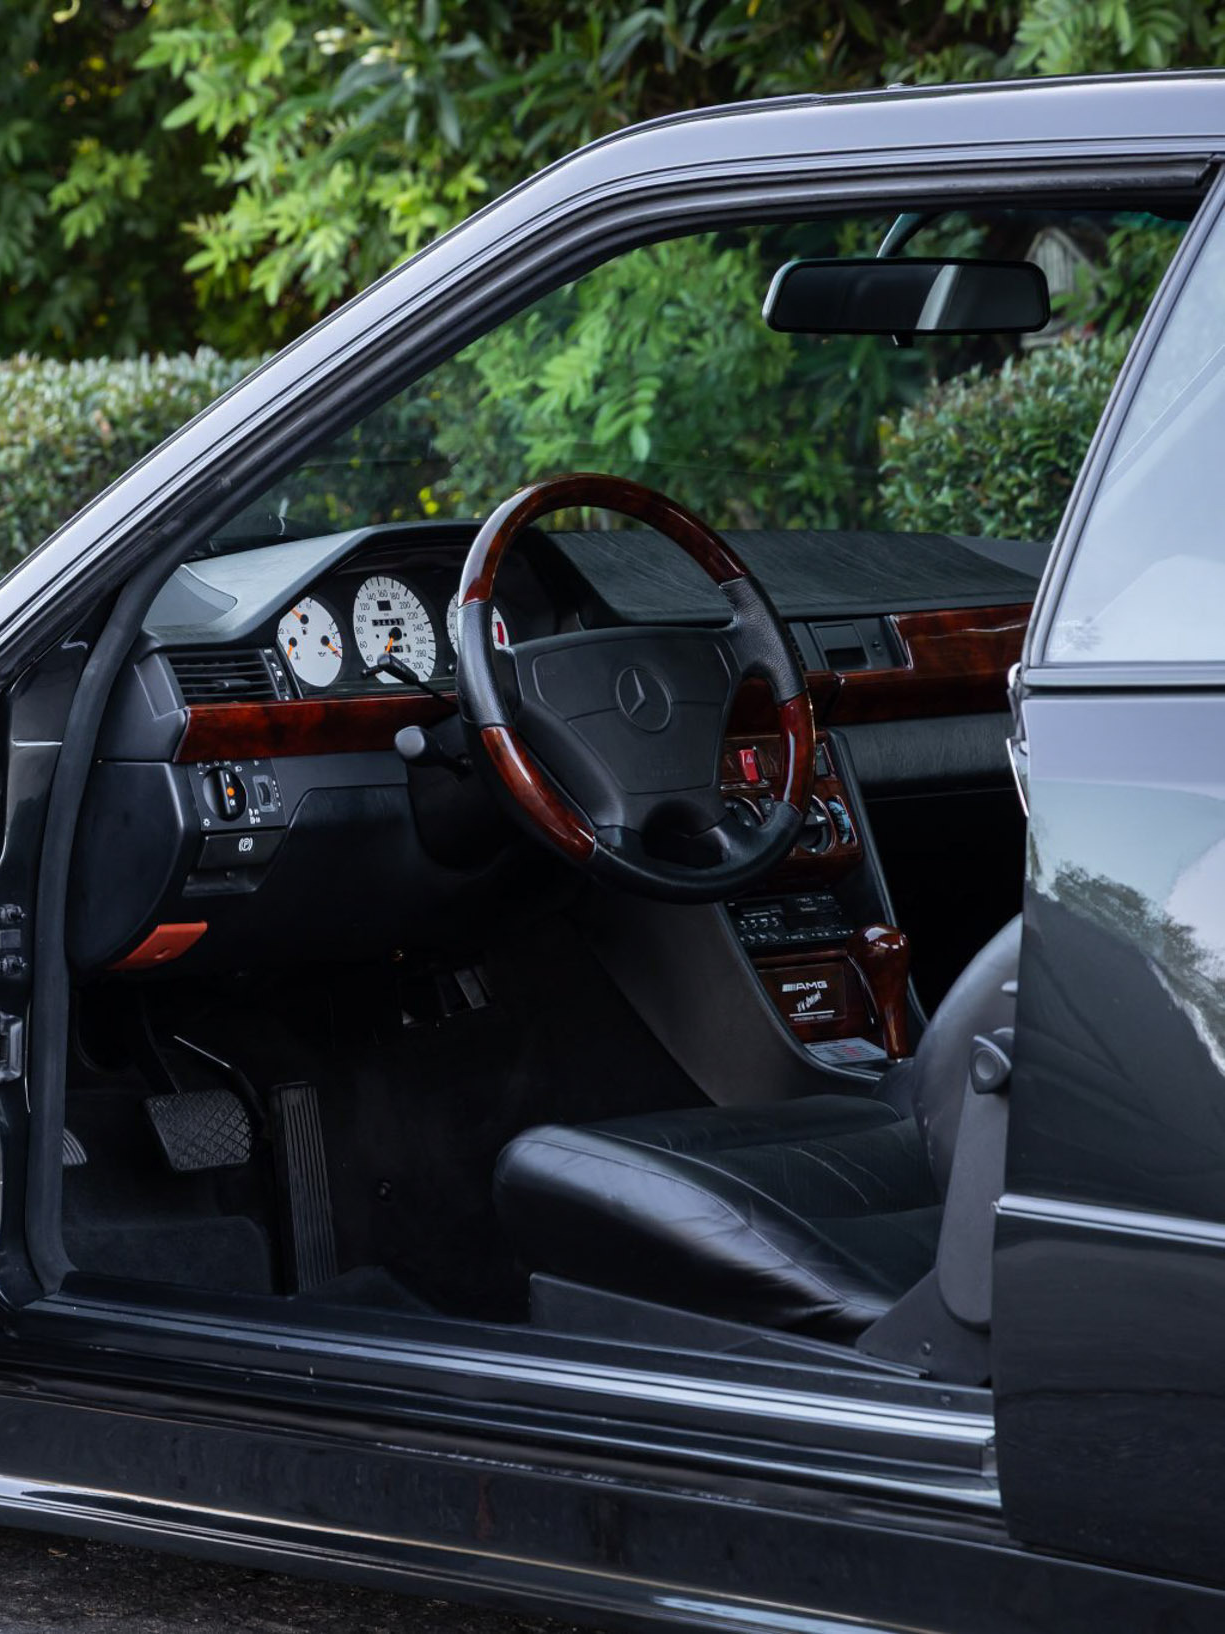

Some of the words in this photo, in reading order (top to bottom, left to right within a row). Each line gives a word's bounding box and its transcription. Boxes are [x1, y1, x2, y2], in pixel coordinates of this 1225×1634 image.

[399, 602, 410, 610] 200
[407, 612, 418, 620] 220
[412, 624, 424, 632] 240
[415, 636, 427, 644] 260
[359, 641, 368, 649] 60
[415, 649, 427, 658] 280
[366, 654, 374, 662] 40
[412, 661, 424, 670] 300
[796, 980, 828, 991] AMG
